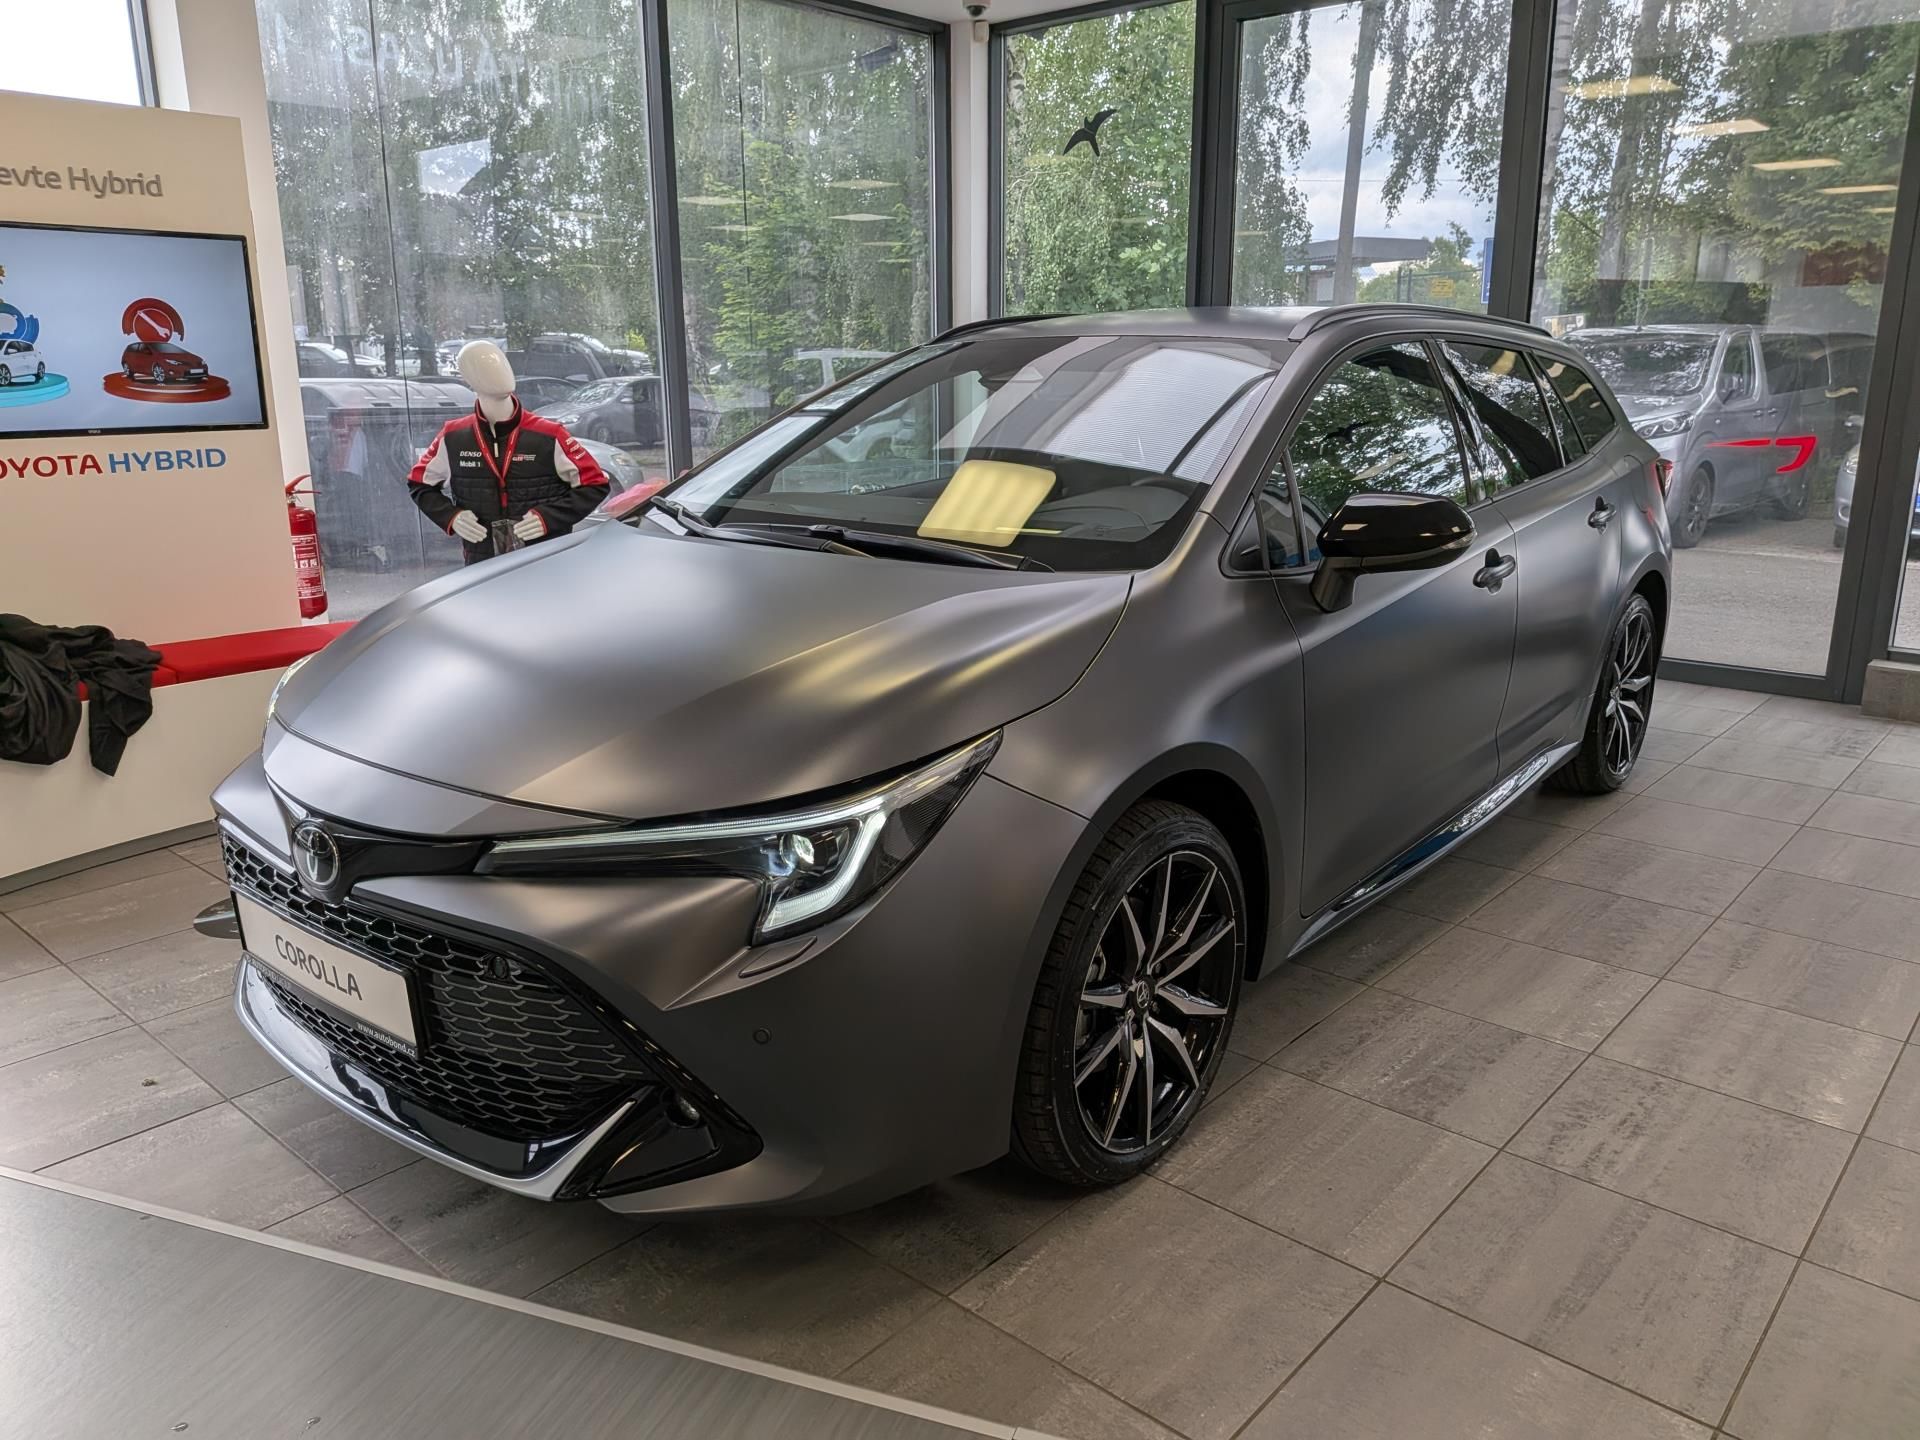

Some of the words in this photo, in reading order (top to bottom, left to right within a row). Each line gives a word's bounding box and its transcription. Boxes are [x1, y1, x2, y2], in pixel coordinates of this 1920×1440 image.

[67, 166, 163, 199] Hybrid
[0, 454, 103, 479] YOTA
[109, 448, 226, 473] HYBRID
[275, 934, 362, 1001] COROLLA
[356, 1021, 416, 1058] www.autobond.cz
